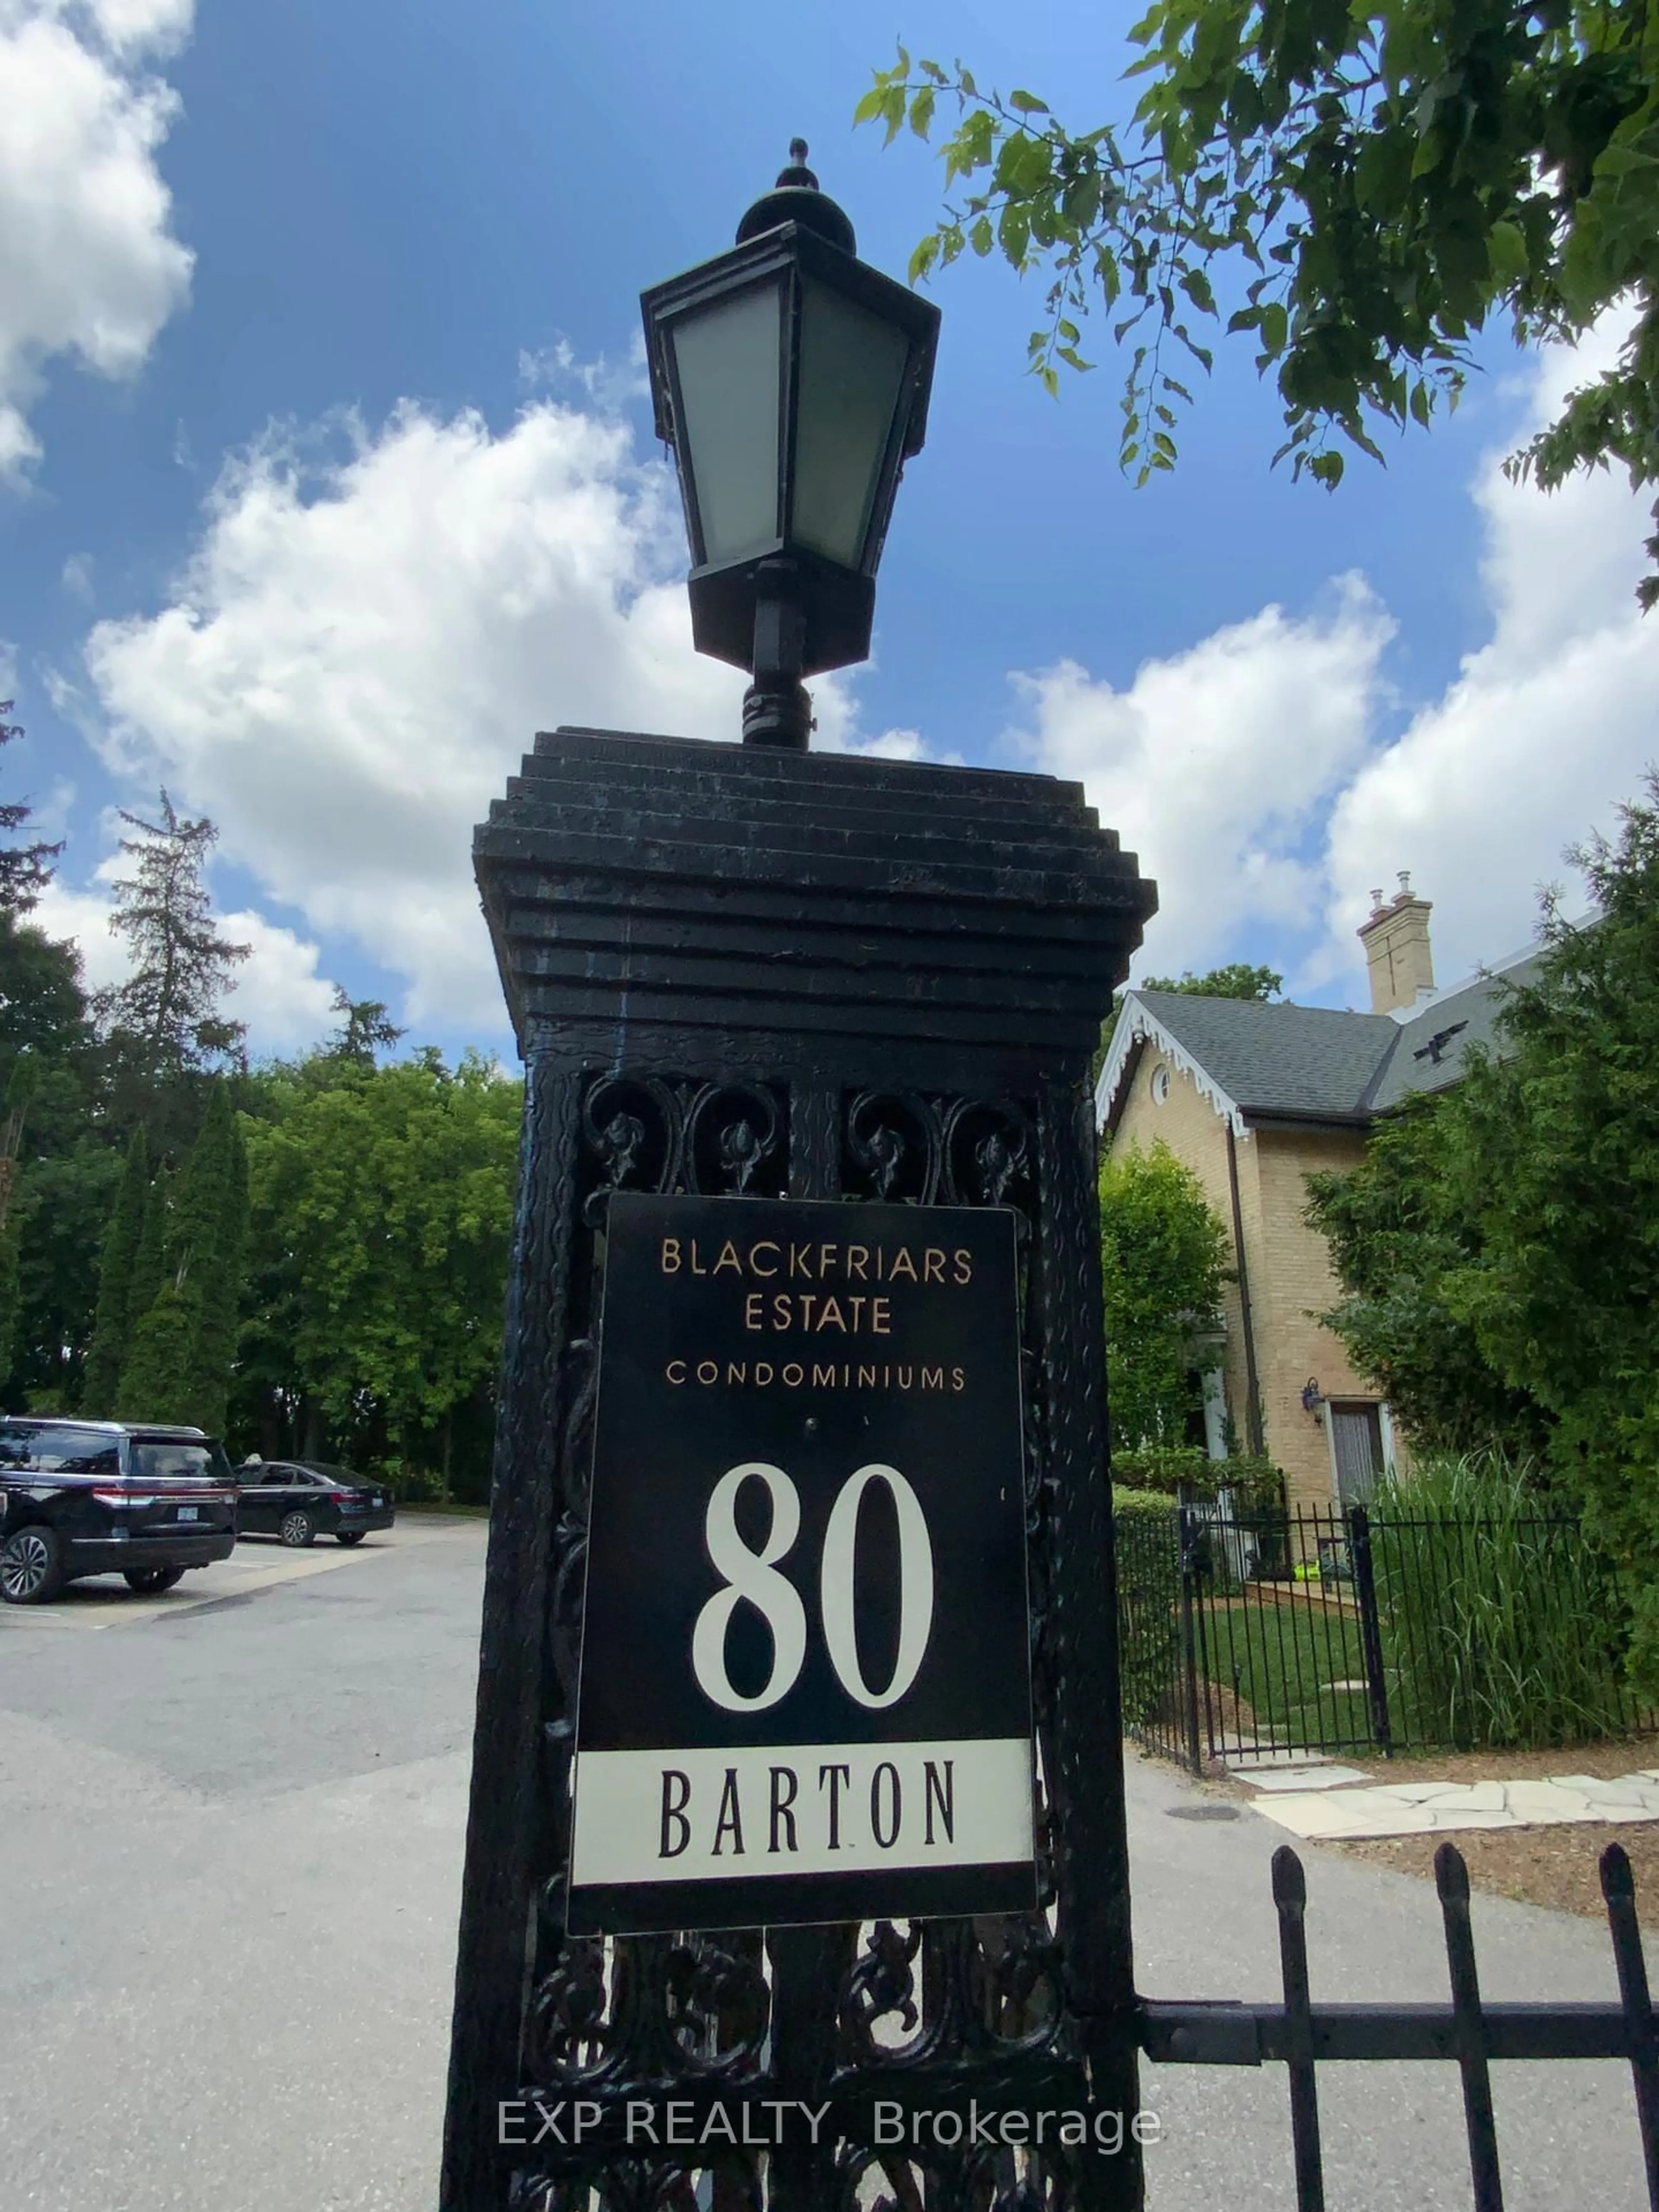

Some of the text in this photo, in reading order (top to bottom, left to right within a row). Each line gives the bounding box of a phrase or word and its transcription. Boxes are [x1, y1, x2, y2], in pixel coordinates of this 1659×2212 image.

[661, 1238, 973, 1284] BLACKFRIARS
[746, 1294, 891, 1333] ESTATE
[666, 1360, 966, 1391] CONDOMINIUMS
[692, 1462, 934, 1713] 80
[658, 1760, 954, 1858] BARTON
